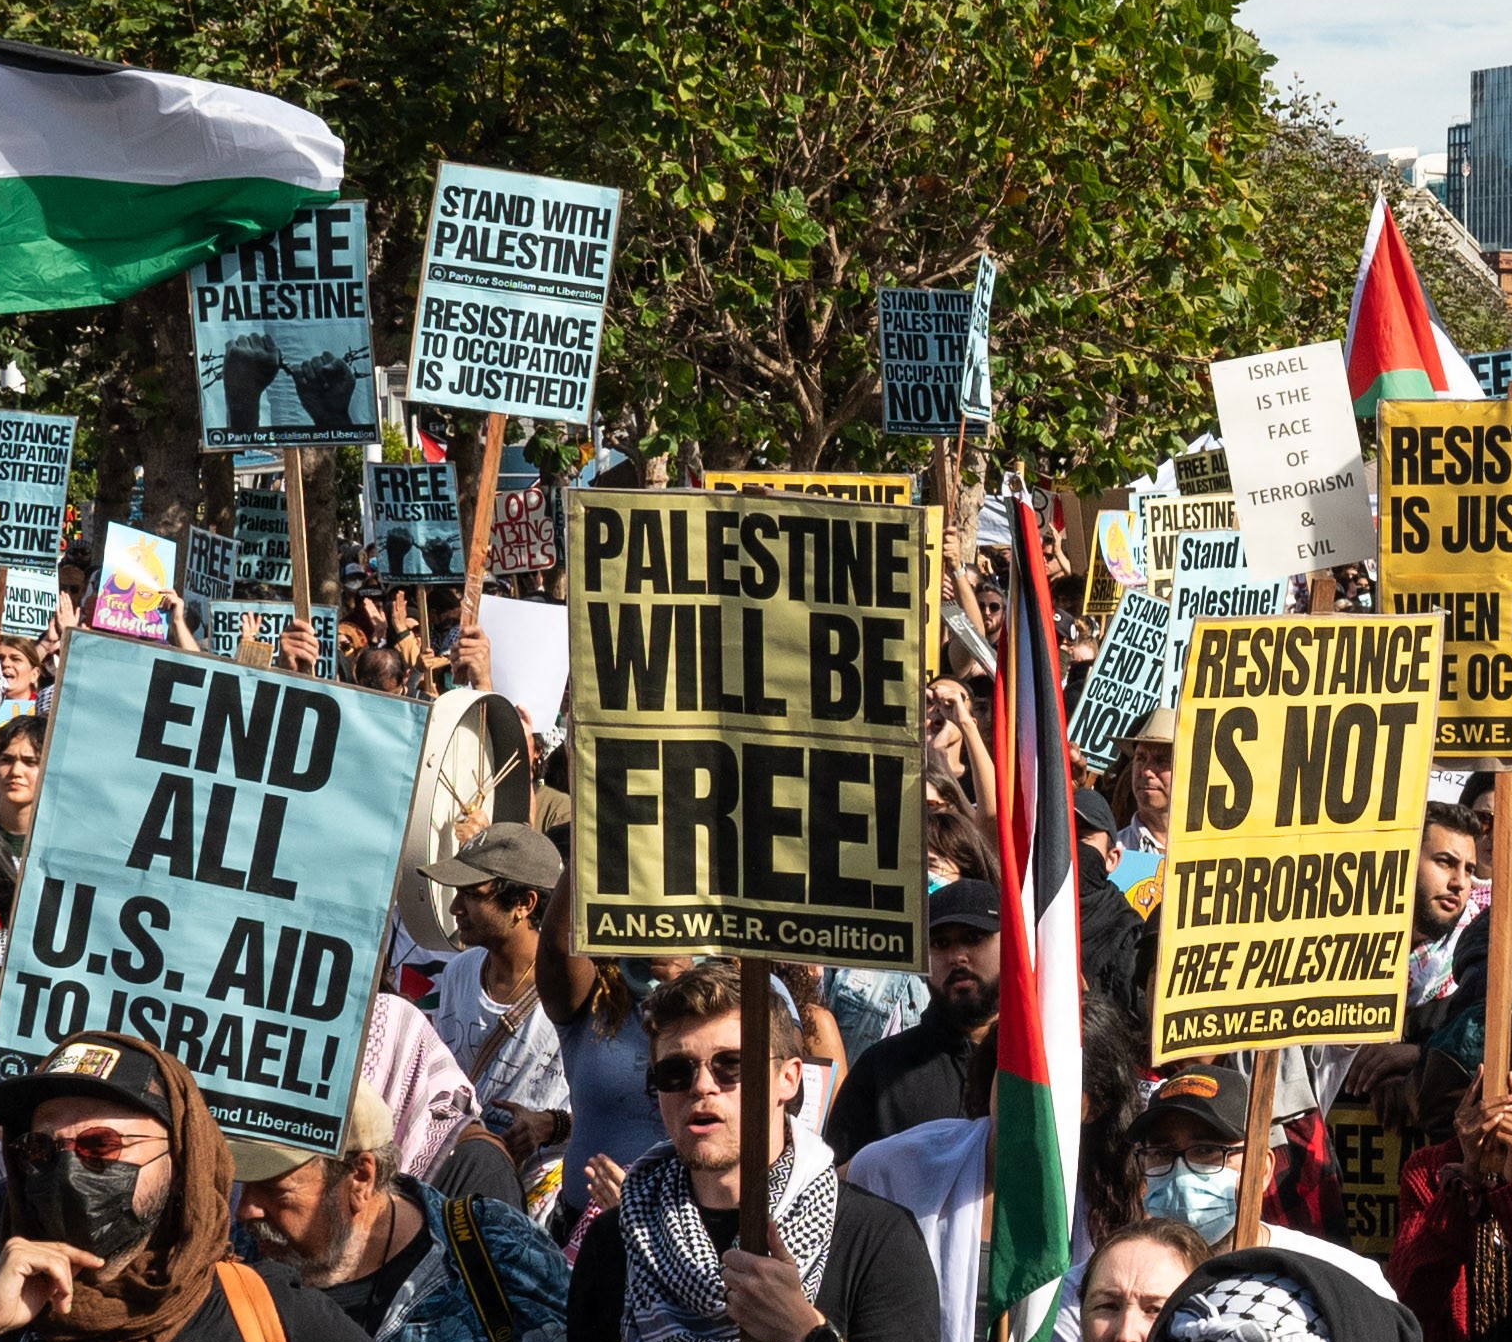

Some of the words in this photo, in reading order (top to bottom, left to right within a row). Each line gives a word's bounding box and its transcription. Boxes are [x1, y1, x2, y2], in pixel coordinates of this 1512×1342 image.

[440, 186, 535, 228] STAND
[541, 199, 612, 239] WITH
[433, 221, 606, 280] PALESTINE
[449, 271, 473, 284] Party
[476, 275, 489, 284] for
[492, 277, 536, 291] Socialism
[538, 284, 554, 294] and
[557, 286, 601, 300] Liberation
[423, 297, 597, 352] RESISTANCE
[421, 331, 448, 357] TO
[451, 334, 592, 379] OCCUPATION
[1248, 356, 1309, 380] ISRAEL
[415, 359, 445, 390] IS
[449, 365, 588, 412] JUSTIFIED!
[1256, 394, 1272, 411] IS
[1276, 387, 1311, 407] THE
[1268, 419, 1312, 441] FACE
[1286, 449, 1311, 467] OF
[1248, 473, 1355, 507] TERRORISM
[1301, 511, 1316, 529] &
[1390, 498, 1431, 553] IS
[585, 506, 910, 609] PALESTINE
[1297, 541, 1336, 560] EVIL
[1394, 592, 1506, 642] WHEN
[587, 602, 787, 717] WILL
[810, 612, 906, 726] BE
[1192, 625, 1433, 700] RESISTANCE
[135, 658, 341, 793] END
[1186, 707, 1258, 832] IS
[1275, 702, 1418, 827] NOT
[125, 771, 299, 900] ALL
[594, 737, 905, 912] FREE!
[1175, 849, 1405, 931] TERRORISM!
[32, 878, 186, 992] U.S.
[206, 917, 354, 1022] AID
[596, 912, 771, 942] A.N.S.W.E.R.
[778, 920, 905, 953] Coalition
[1165, 943, 1234, 999] FREE
[1237, 932, 1402, 992] PALESTINE!
[16, 971, 90, 1044] TO
[107, 990, 342, 1100] ISRAEL!
[1165, 1009, 1287, 1045] A.N.S.W.E.R.
[1292, 1003, 1391, 1029] Coalition
[208, 1106, 240, 1123] and
[246, 1112, 335, 1142] Liberation
